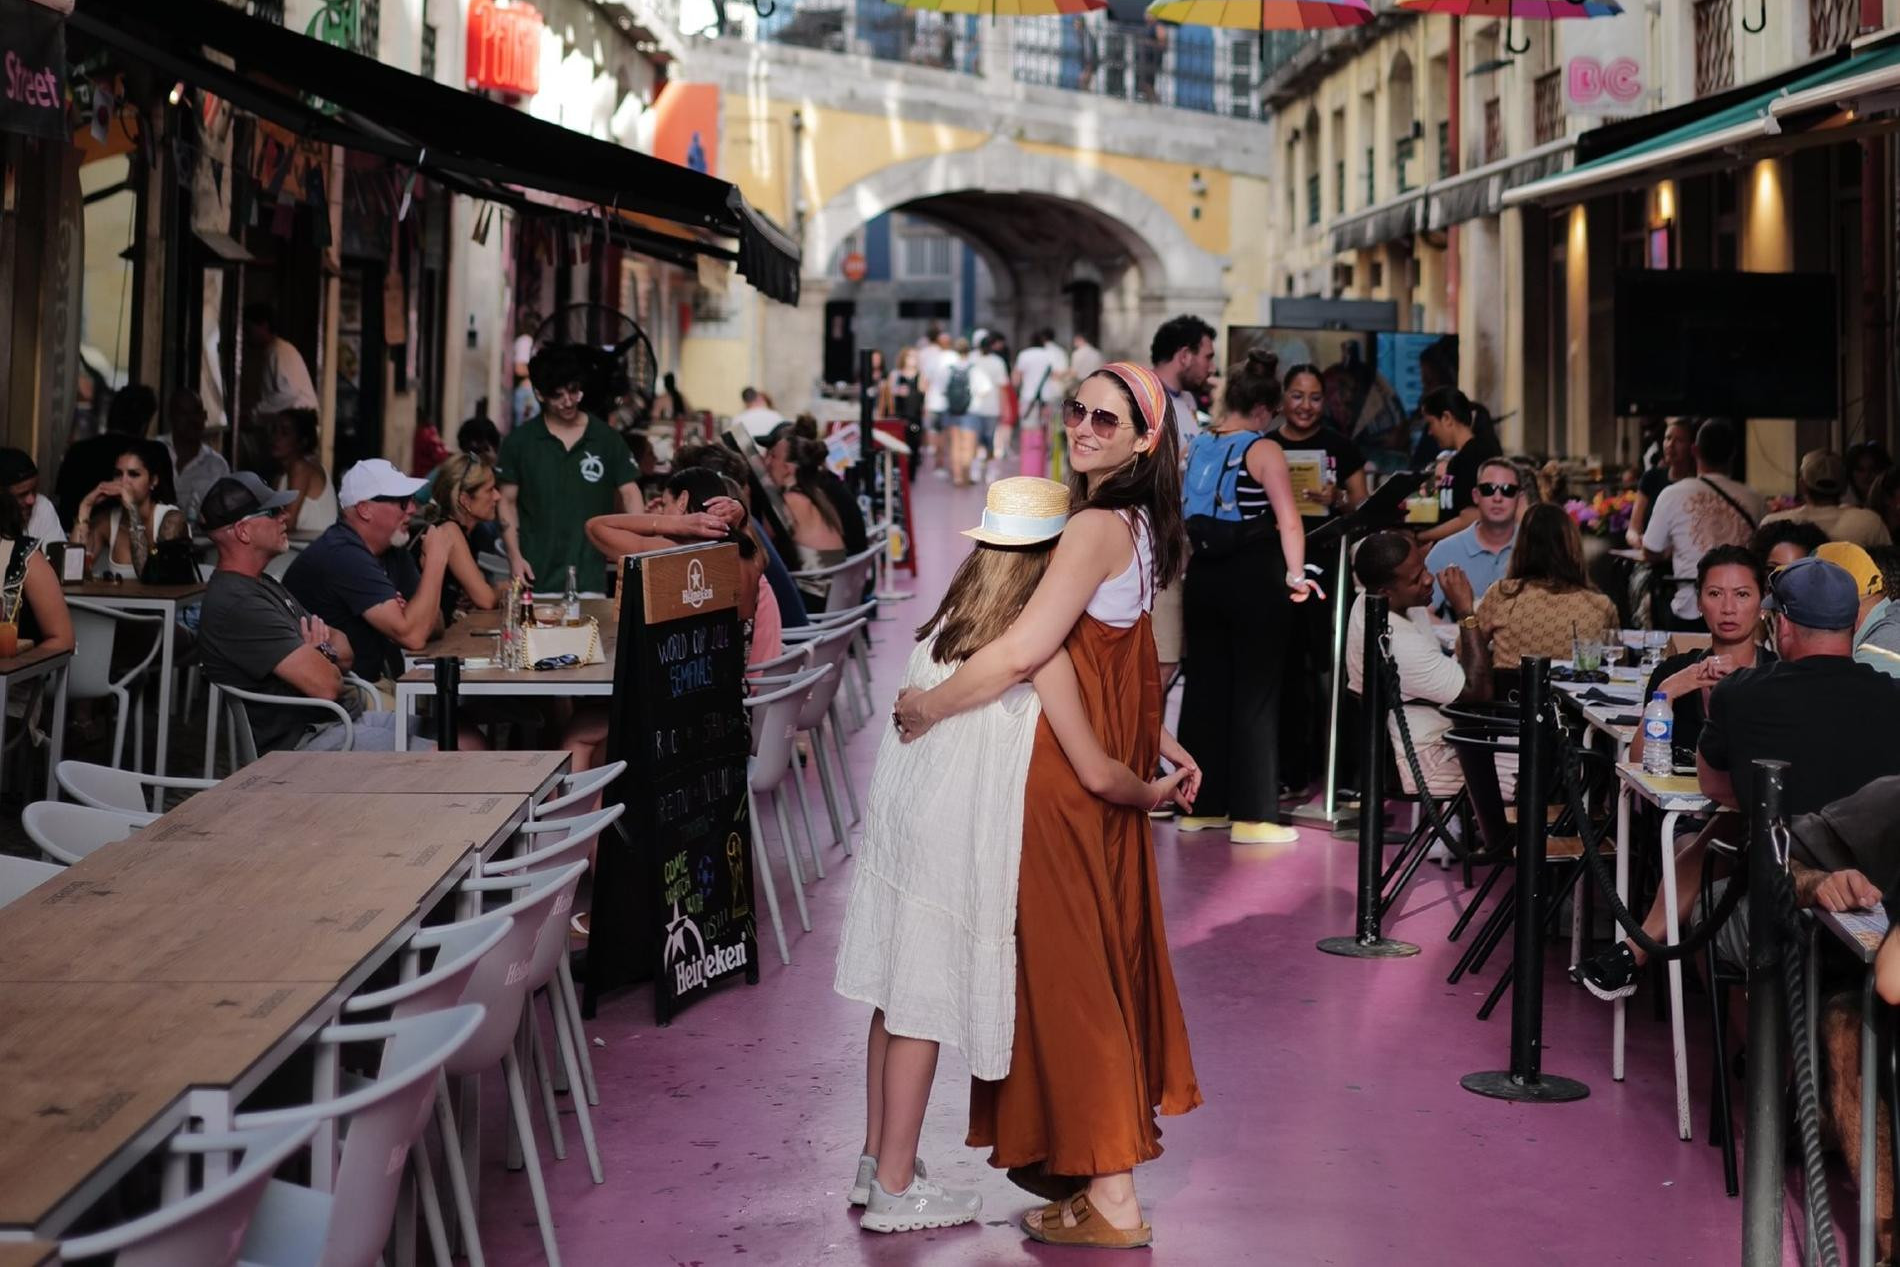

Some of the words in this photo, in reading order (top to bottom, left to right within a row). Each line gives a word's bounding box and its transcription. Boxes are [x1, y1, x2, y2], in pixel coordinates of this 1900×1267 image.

[5, 50, 60, 109] Street
[657, 632, 688, 666] WORLD
[664, 849, 689, 886] COME
[674, 940, 747, 996] Heineken
